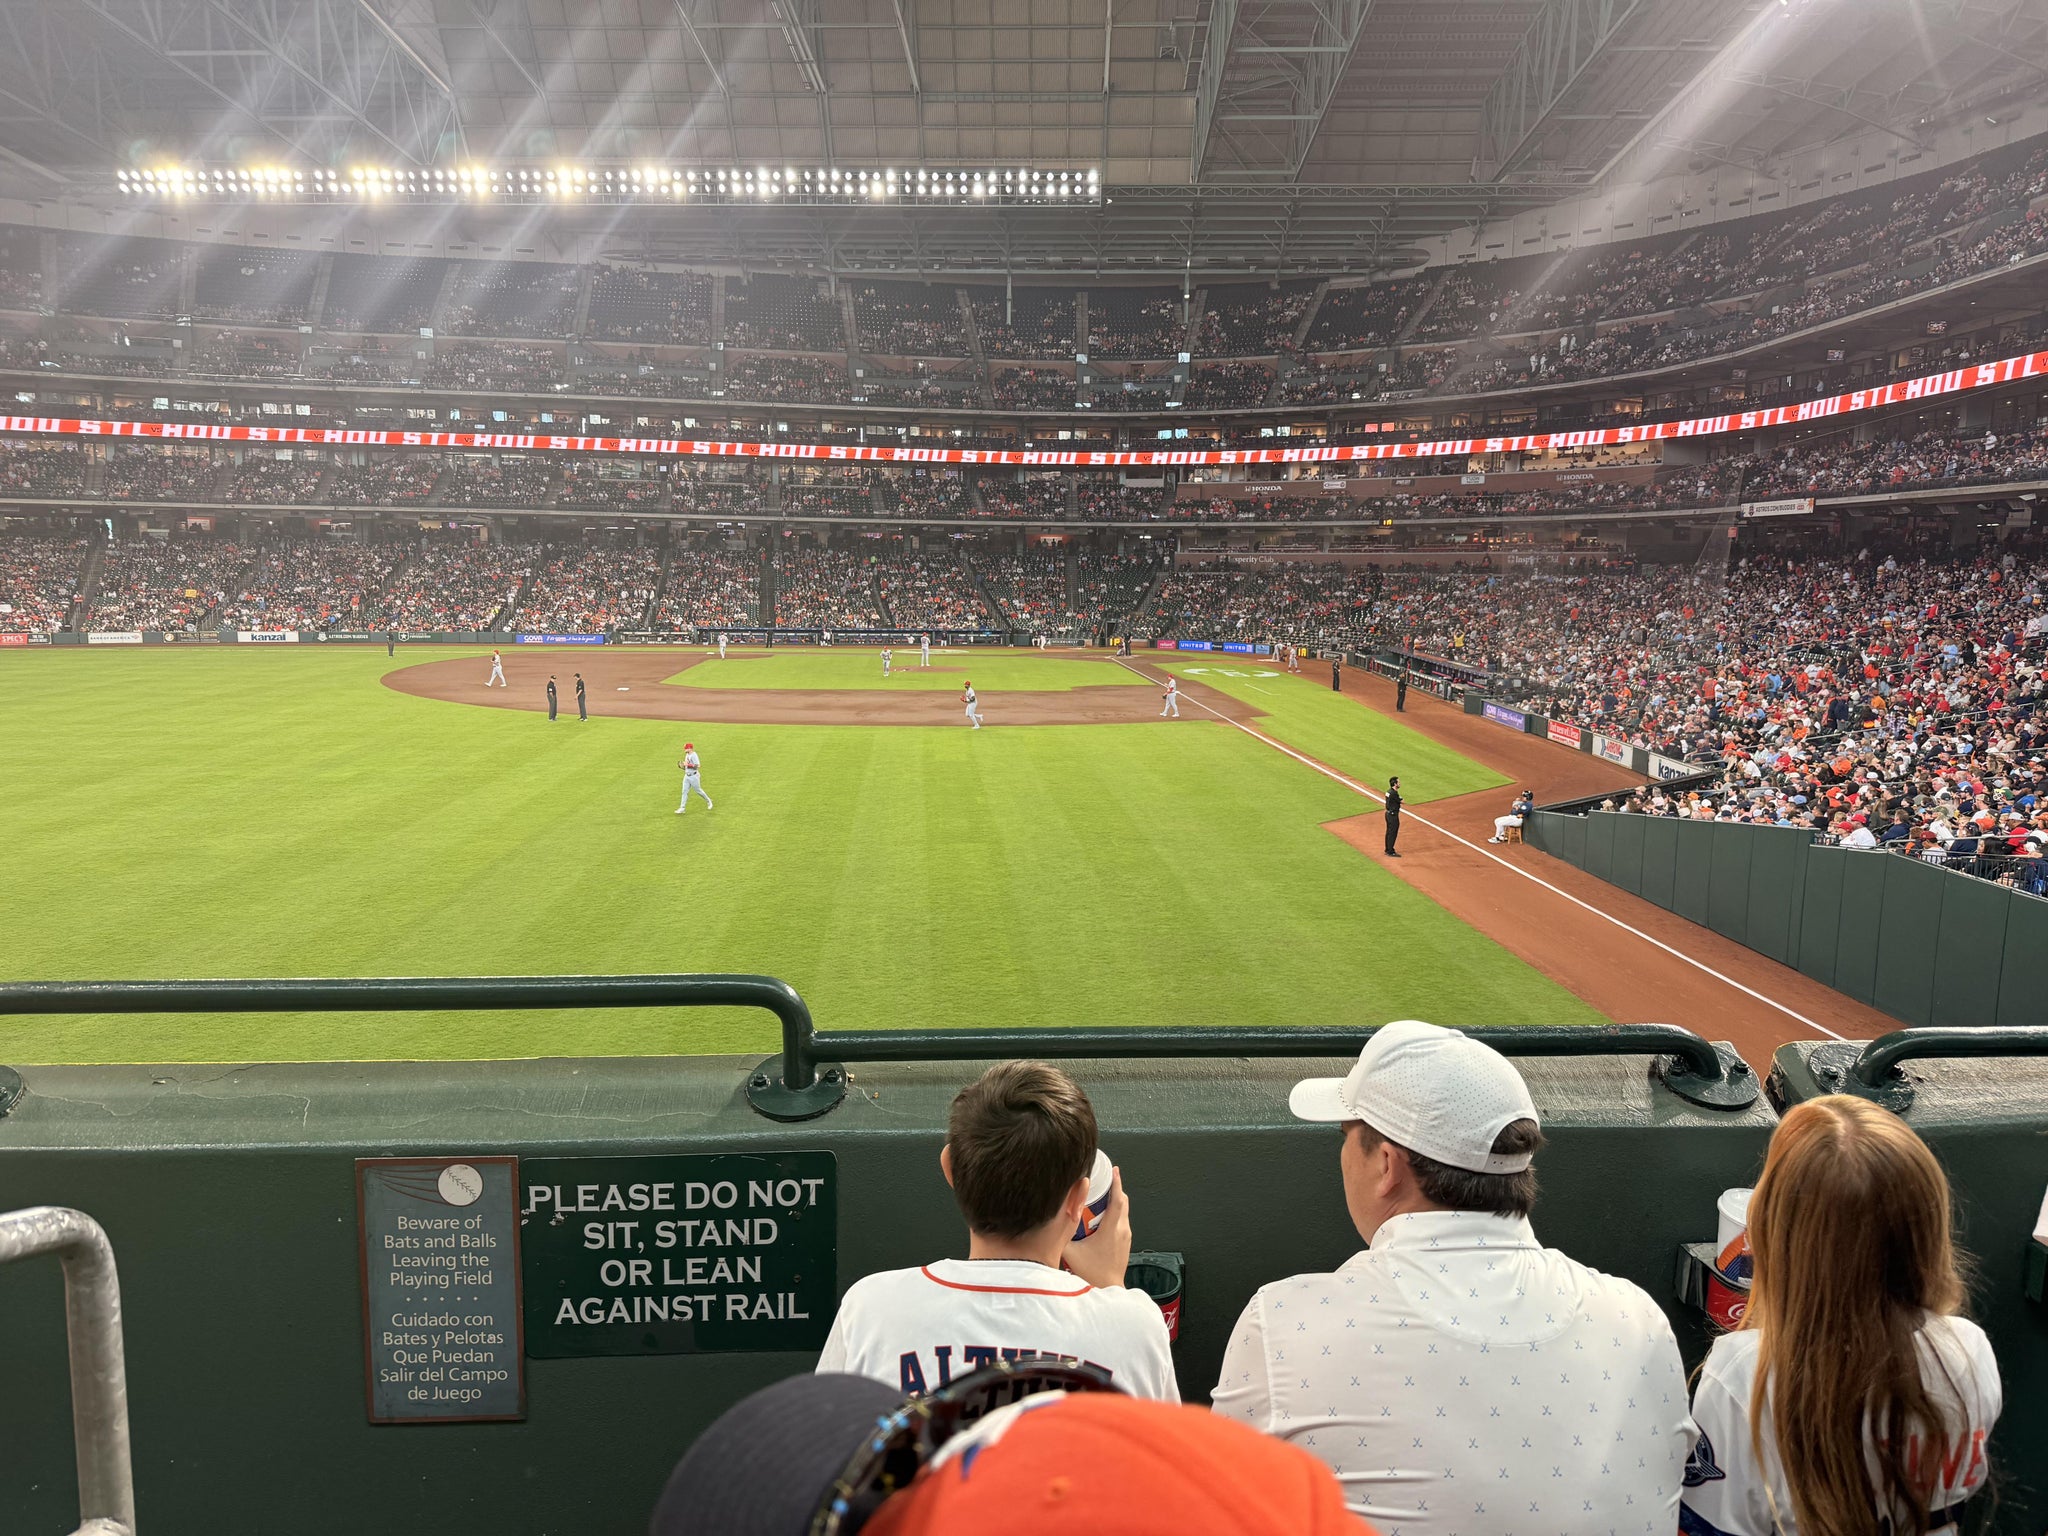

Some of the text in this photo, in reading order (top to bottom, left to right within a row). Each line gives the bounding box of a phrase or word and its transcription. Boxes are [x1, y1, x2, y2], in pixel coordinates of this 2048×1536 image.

[78, 420, 149, 436] STL
[162, 424, 232, 439] HOU
[248, 428, 312, 442] STL
[324, 430, 387, 444] HOU
[402, 432, 465, 445] STL
[474, 434, 534, 448] HOU
[550, 436, 608, 450] STL
[619, 439, 678, 452] HOU
[692, 442, 750, 455] STL
[759, 444, 816, 457] HOU
[829, 447, 885, 459] STL
[893, 449, 948, 461] HOU
[961, 451, 1014, 463] STL
[1022, 452, 1076, 464] HOU
[1089, 453, 1143, 464] STL
[1151, 452, 1207, 464] HOU
[1219, 450, 1274, 463] STL
[1282, 448, 1339, 461] HOU
[1351, 444, 1407, 459] STL
[1416, 440, 1472, 456] HOU
[1484, 436, 1540, 452] STL
[1549, 430, 1606, 448] HOU
[1617, 424, 1669, 442] STL
[1677, 416, 1730, 436] HOU
[1739, 407, 1791, 429] STL
[1798, 396, 1840, 420] HOU
[1850, 385, 1899, 410] STL
[1906, 370, 1963, 399] HOU
[1974, 354, 2040, 386] STL
[1259, 555, 1274, 563] Club
[528, 1178, 824, 1214] PLEASE DO NOT
[397, 1214, 483, 1231] Beware of
[384, 1233, 497, 1249] Bats and Balls
[582, 1217, 778, 1253] SIT, STAND
[392, 1252, 490, 1271] Leaving the
[600, 1256, 761, 1287] OR LEAN
[390, 1270, 493, 1290] Playing Field
[554, 1292, 809, 1325] AGAINST RAIL
[391, 1312, 494, 1328] Cuidado con
[383, 1330, 504, 1350] Bates y Pelotas
[393, 1348, 494, 1365] Que Puedan
[380, 1366, 508, 1387] Salir del Campo
[407, 1385, 482, 1405] de Juego
